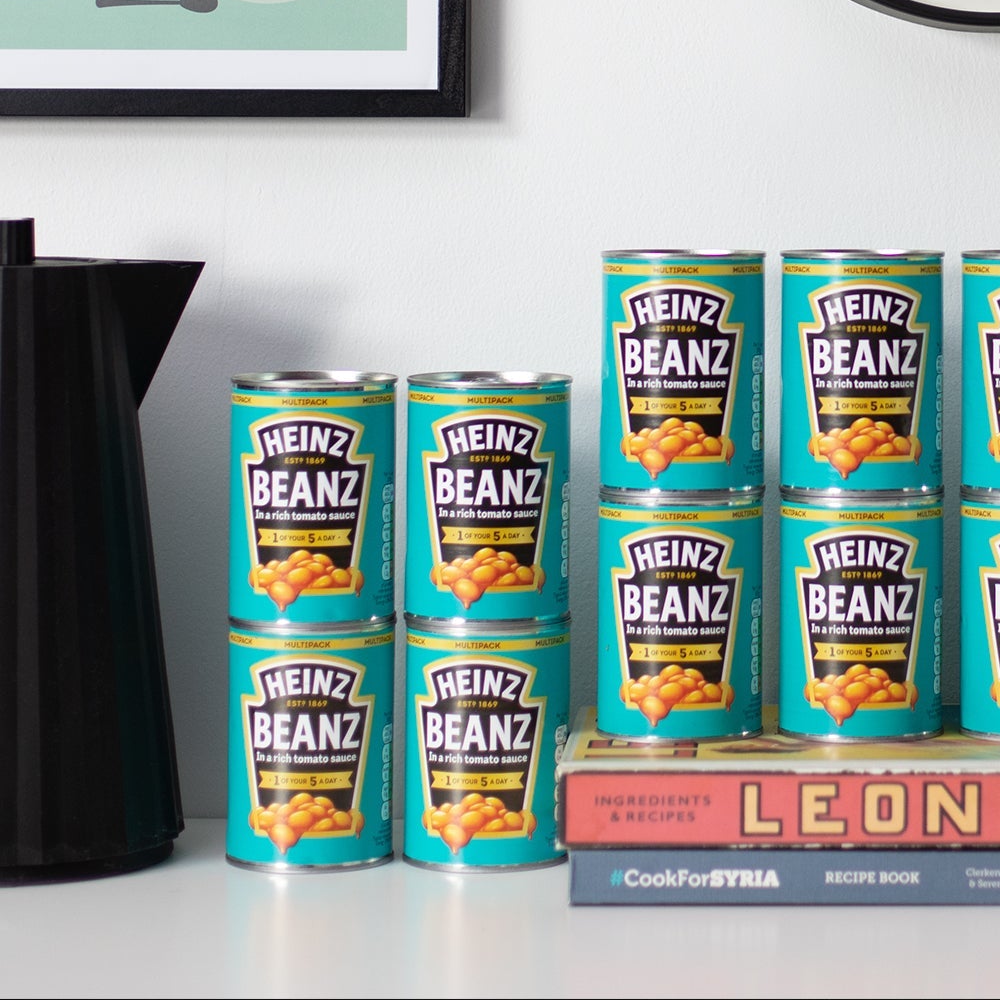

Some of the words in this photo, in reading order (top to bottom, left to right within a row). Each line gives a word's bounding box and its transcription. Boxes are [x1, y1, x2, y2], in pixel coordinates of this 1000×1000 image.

[844, 267, 890, 275] MULTIPACK
[635, 294, 721, 326] HEINZ
[826, 294, 910, 326] HEINZ
[624, 338, 730, 376] BEANZ
[814, 338, 920, 376] BEANZ
[627, 378, 636, 387] In
[643, 379, 662, 389] rich
[663, 380, 698, 389] tomato
[815, 378, 824, 388] In
[834, 379, 852, 389] rich
[854, 380, 889, 389] tomato
[282, 398, 328, 406] MULTIPACK
[468, 397, 514, 405] MULTIPACK
[264, 426, 350, 458] HEINZ
[449, 424, 535, 456] HEINZ
[253, 470, 359, 508] BEANZ
[438, 468, 544, 506] BEANZ
[255, 510, 264, 519] In
[272, 511, 290, 521] rich
[292, 512, 327, 521] tomato
[328, 512, 355, 520] sauce
[653, 513, 699, 521] MULTIPACK
[272, 533, 278, 543] 1
[308, 533, 315, 543] 5
[634, 540, 720, 572] HEINZ
[820, 540, 906, 572] HEINZ
[624, 584, 730, 622] BEANZ
[810, 584, 916, 622] BEANZ
[285, 641, 331, 649] MULTIPACK
[266, 668, 352, 700] HEINZ
[436, 669, 522, 701] HEINZ
[255, 712, 361, 750] BEANZ
[427, 713, 531, 751] BEANZ
[594, 794, 712, 807] INGREDIENTS
[610, 811, 620, 822] &
[626, 811, 696, 822] RECIPES
[741, 781, 982, 837] LEON
[610, 869, 780, 888] #CookForSYRIA
[825, 871, 876, 885] RECIPE
[880, 871, 920, 885] BOOK
